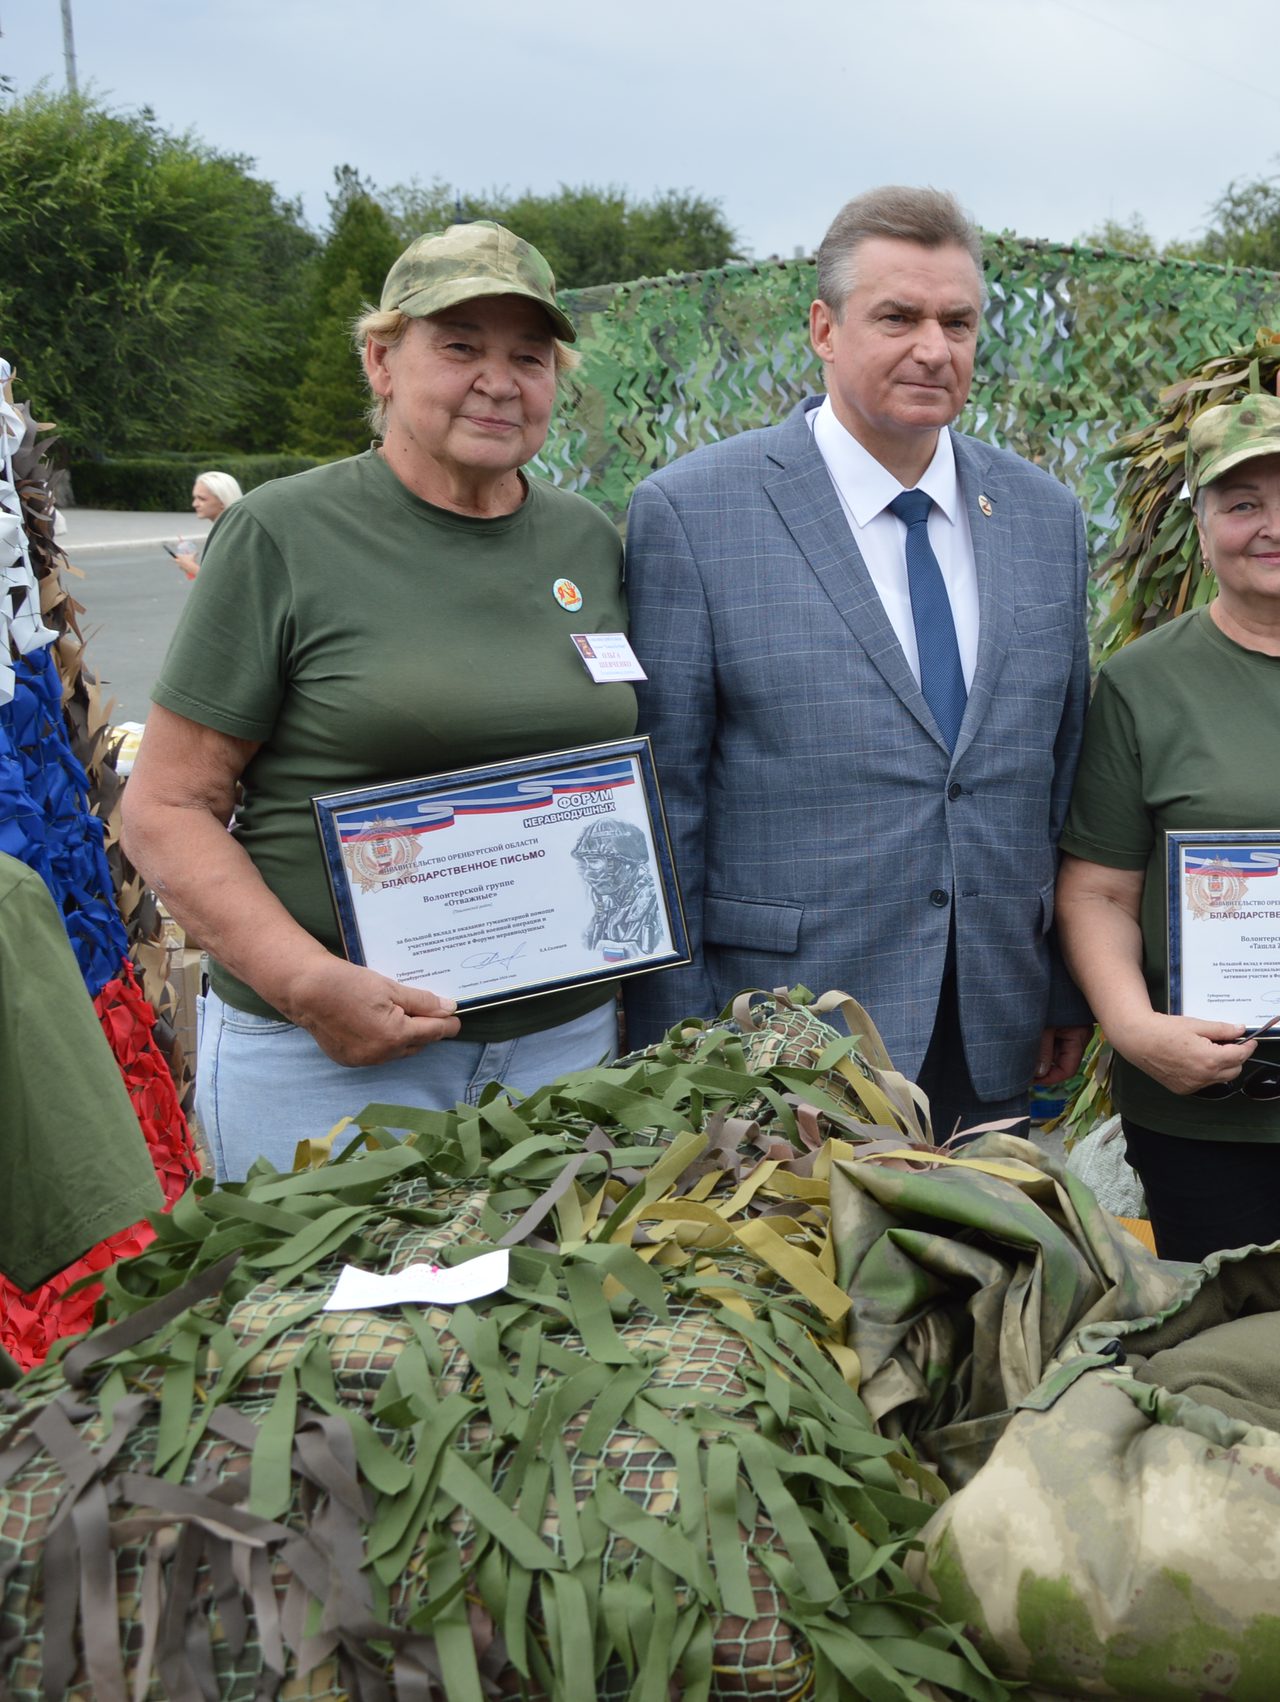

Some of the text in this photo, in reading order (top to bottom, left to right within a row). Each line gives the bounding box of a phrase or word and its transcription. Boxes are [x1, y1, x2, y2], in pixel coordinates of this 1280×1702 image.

[557, 788, 613, 809] ФОРУМ
[523, 801, 616, 828] НЕРАВНОДУШНЫХ
[447, 844, 504, 862] ОРЕНБУРГСКОЙ
[505, 838, 539, 850] ОБЛАСТИ
[382, 849, 546, 889] БЛАГОДАРСТВЕННОЕ ПИСЬМО
[423, 879, 515, 903] Волонтерской группе
[444, 891, 498, 907] «Отважные»
